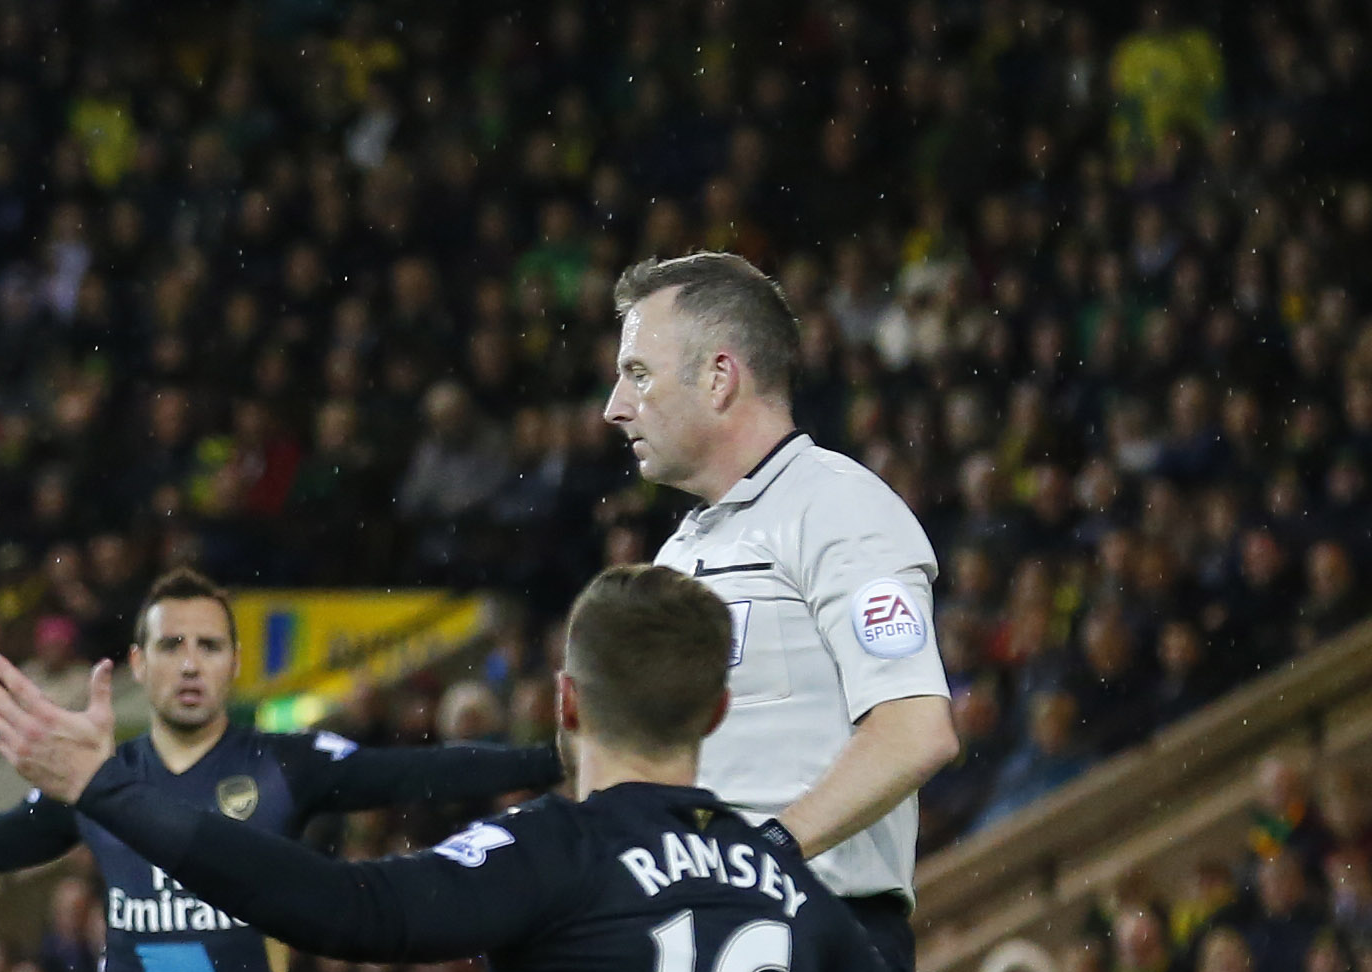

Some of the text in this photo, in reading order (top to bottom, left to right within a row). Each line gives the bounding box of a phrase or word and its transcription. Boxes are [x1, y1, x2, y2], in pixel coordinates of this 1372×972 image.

[863, 595, 917, 627] EA
[864, 622, 922, 642] SPORTS
[618, 831, 808, 918] RAMSEY
[108, 886, 250, 933] Emira
